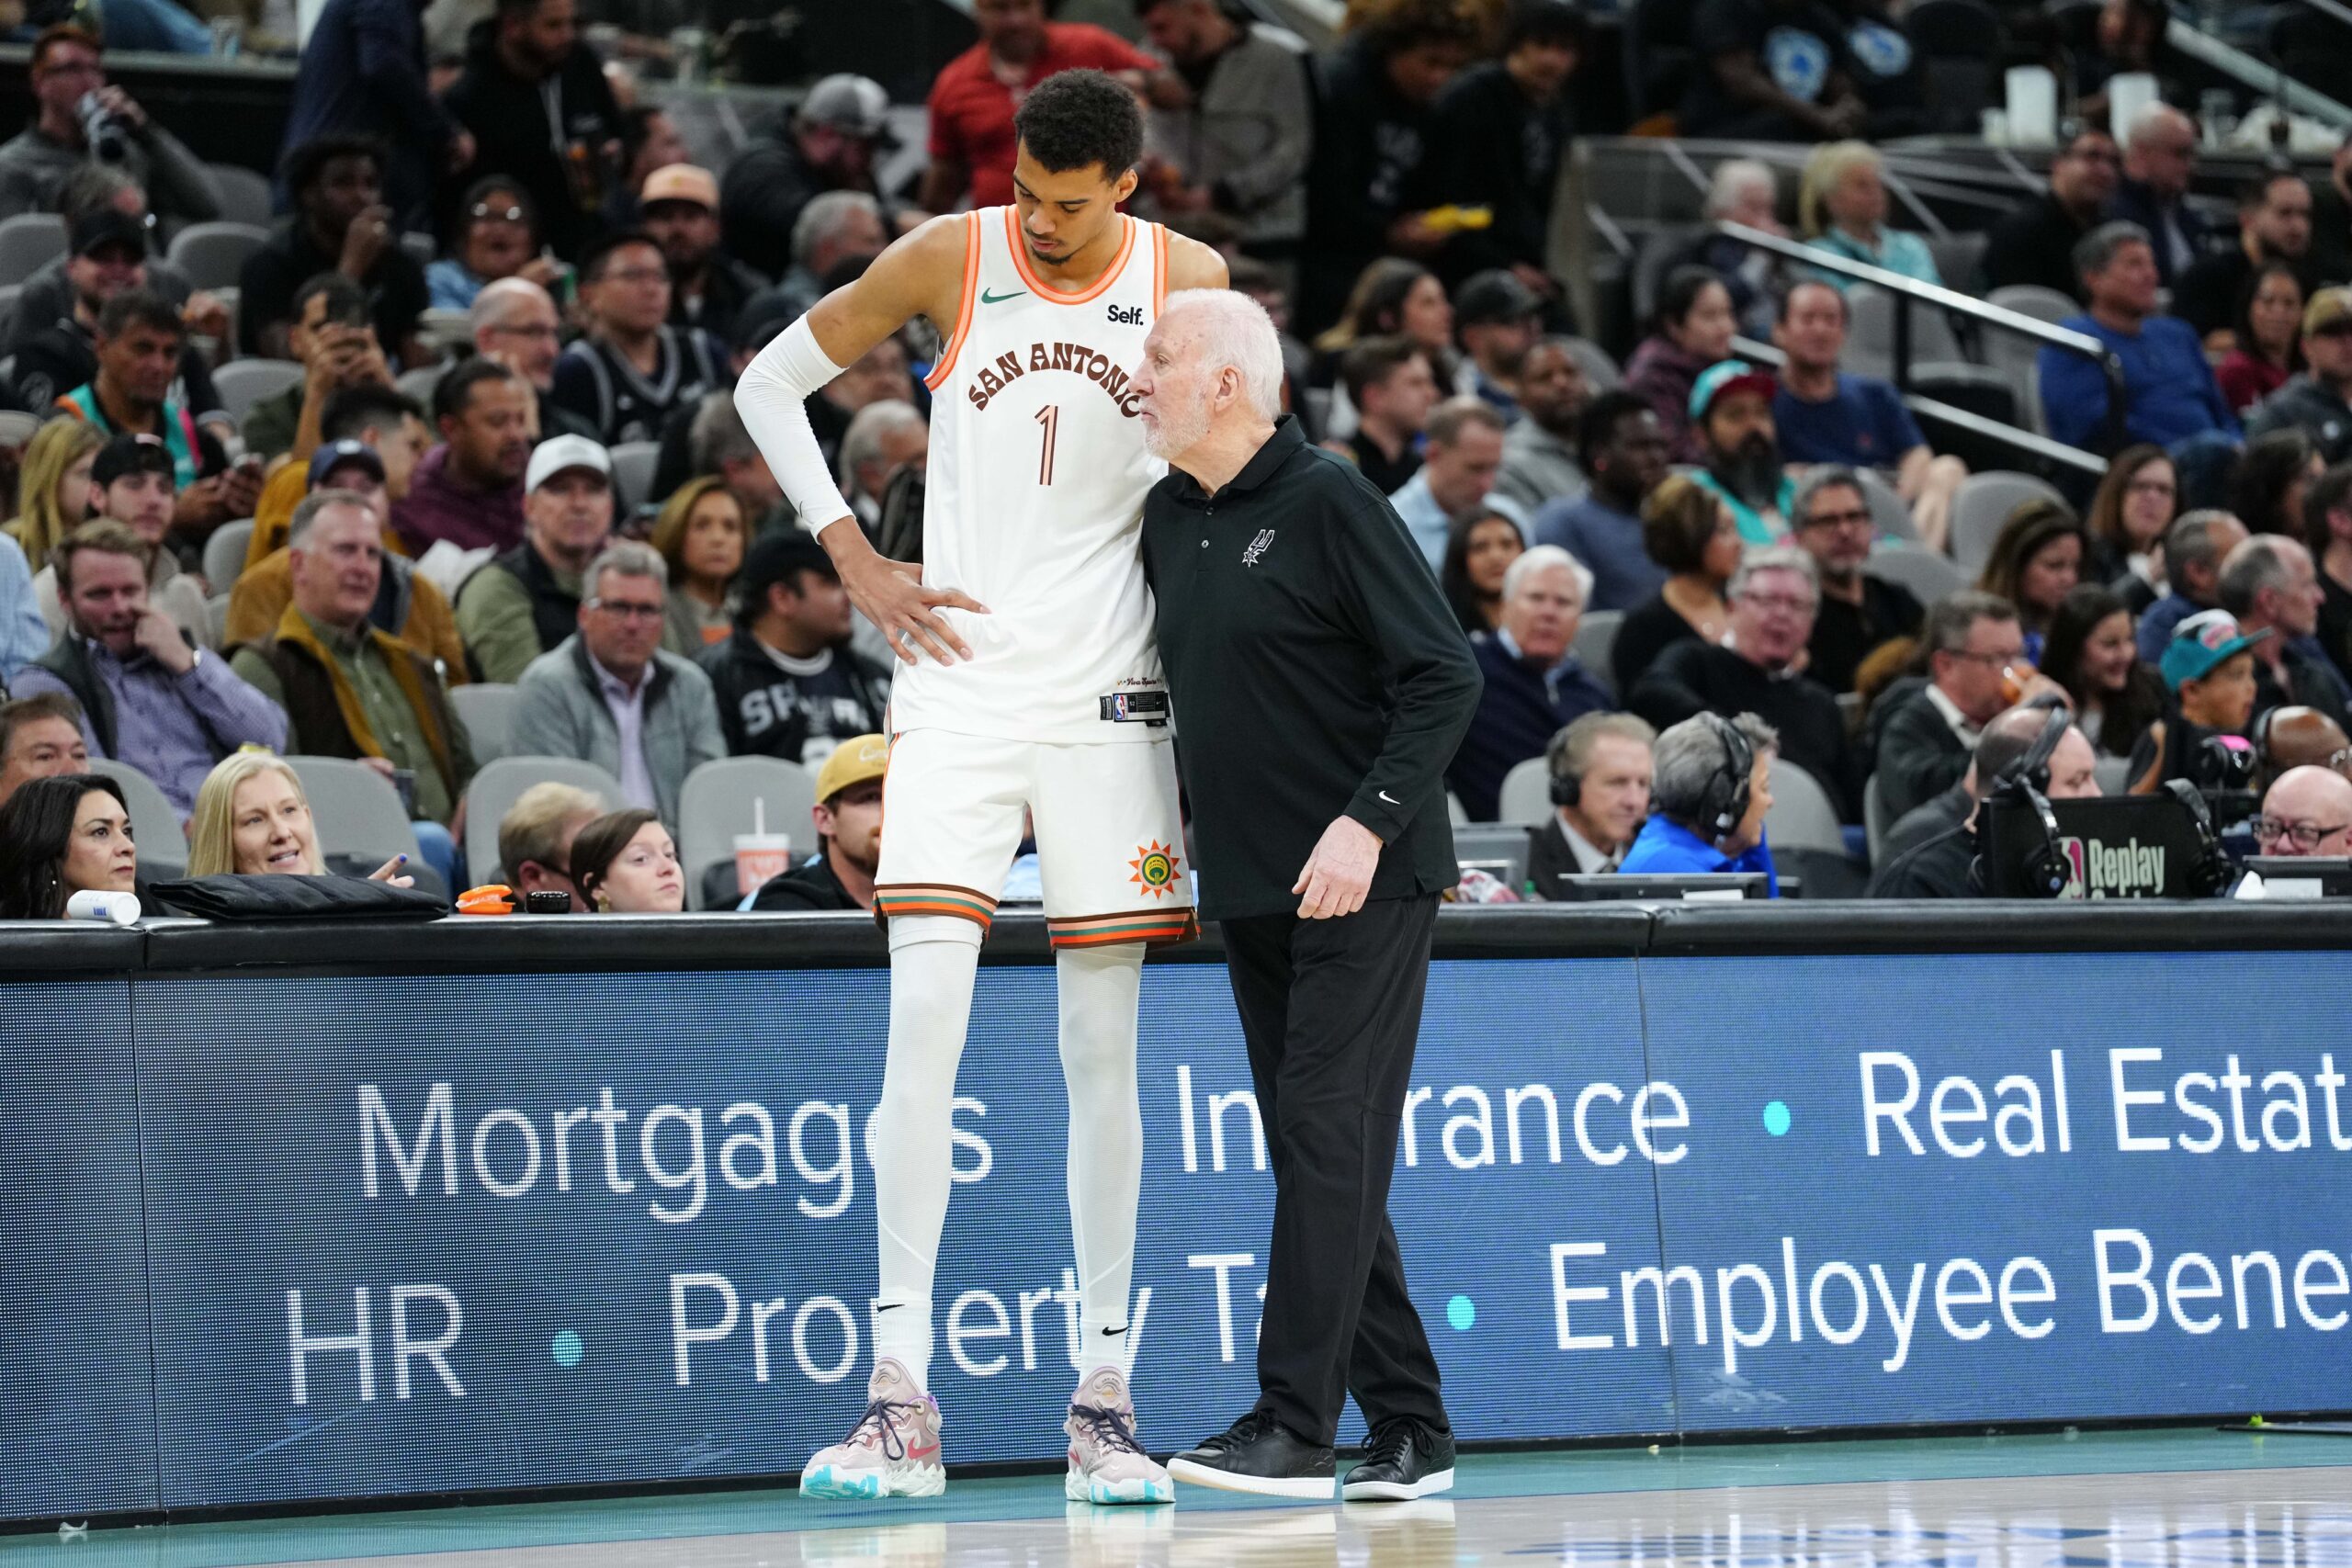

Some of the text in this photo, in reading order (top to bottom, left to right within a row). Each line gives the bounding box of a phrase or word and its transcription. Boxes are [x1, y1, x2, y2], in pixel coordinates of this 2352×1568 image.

[1107, 304, 1144, 326] Self.
[968, 350, 1024, 412] SAN
[1034, 404, 1058, 486] 1
[2088, 837, 2165, 897] Replay
[358, 1083, 993, 1224] Mortgags
[1176, 1064, 1690, 1173] Inrance
[1858, 1047, 2073, 1158] Real
[287, 1284, 465, 1404] HR
[670, 1271, 1152, 1387] Proerty
[1549, 1235, 2057, 1374] Employee
